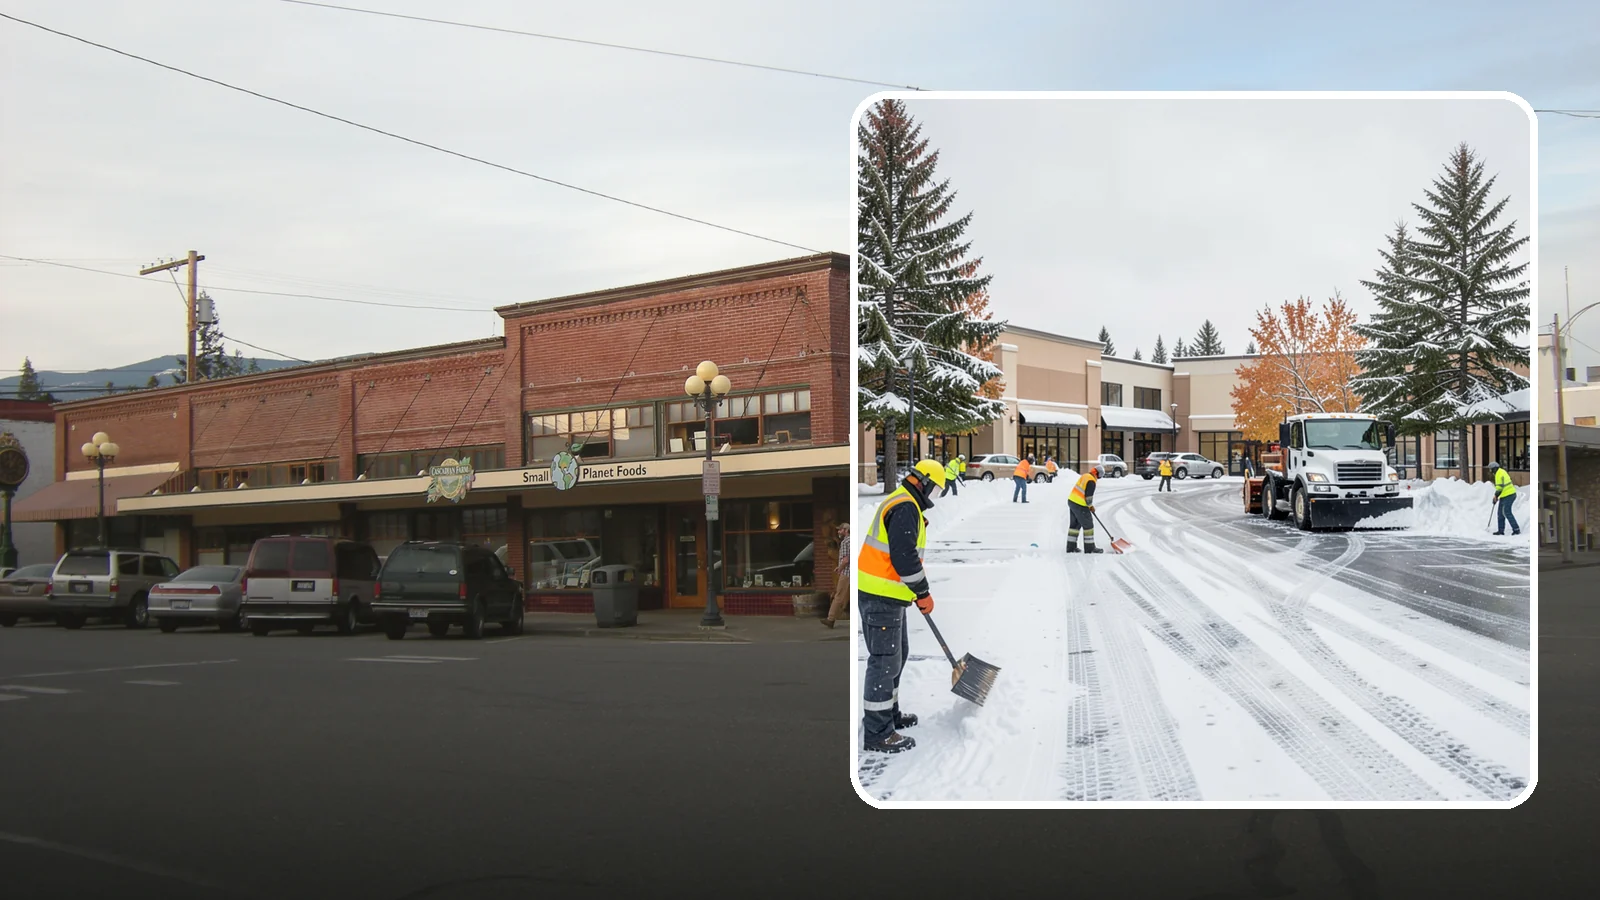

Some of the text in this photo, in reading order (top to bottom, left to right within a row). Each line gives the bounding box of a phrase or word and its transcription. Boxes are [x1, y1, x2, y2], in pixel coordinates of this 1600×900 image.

[431, 466, 455, 476] CASCADIAN
[523, 464, 647, 483] Small Planet Foods
